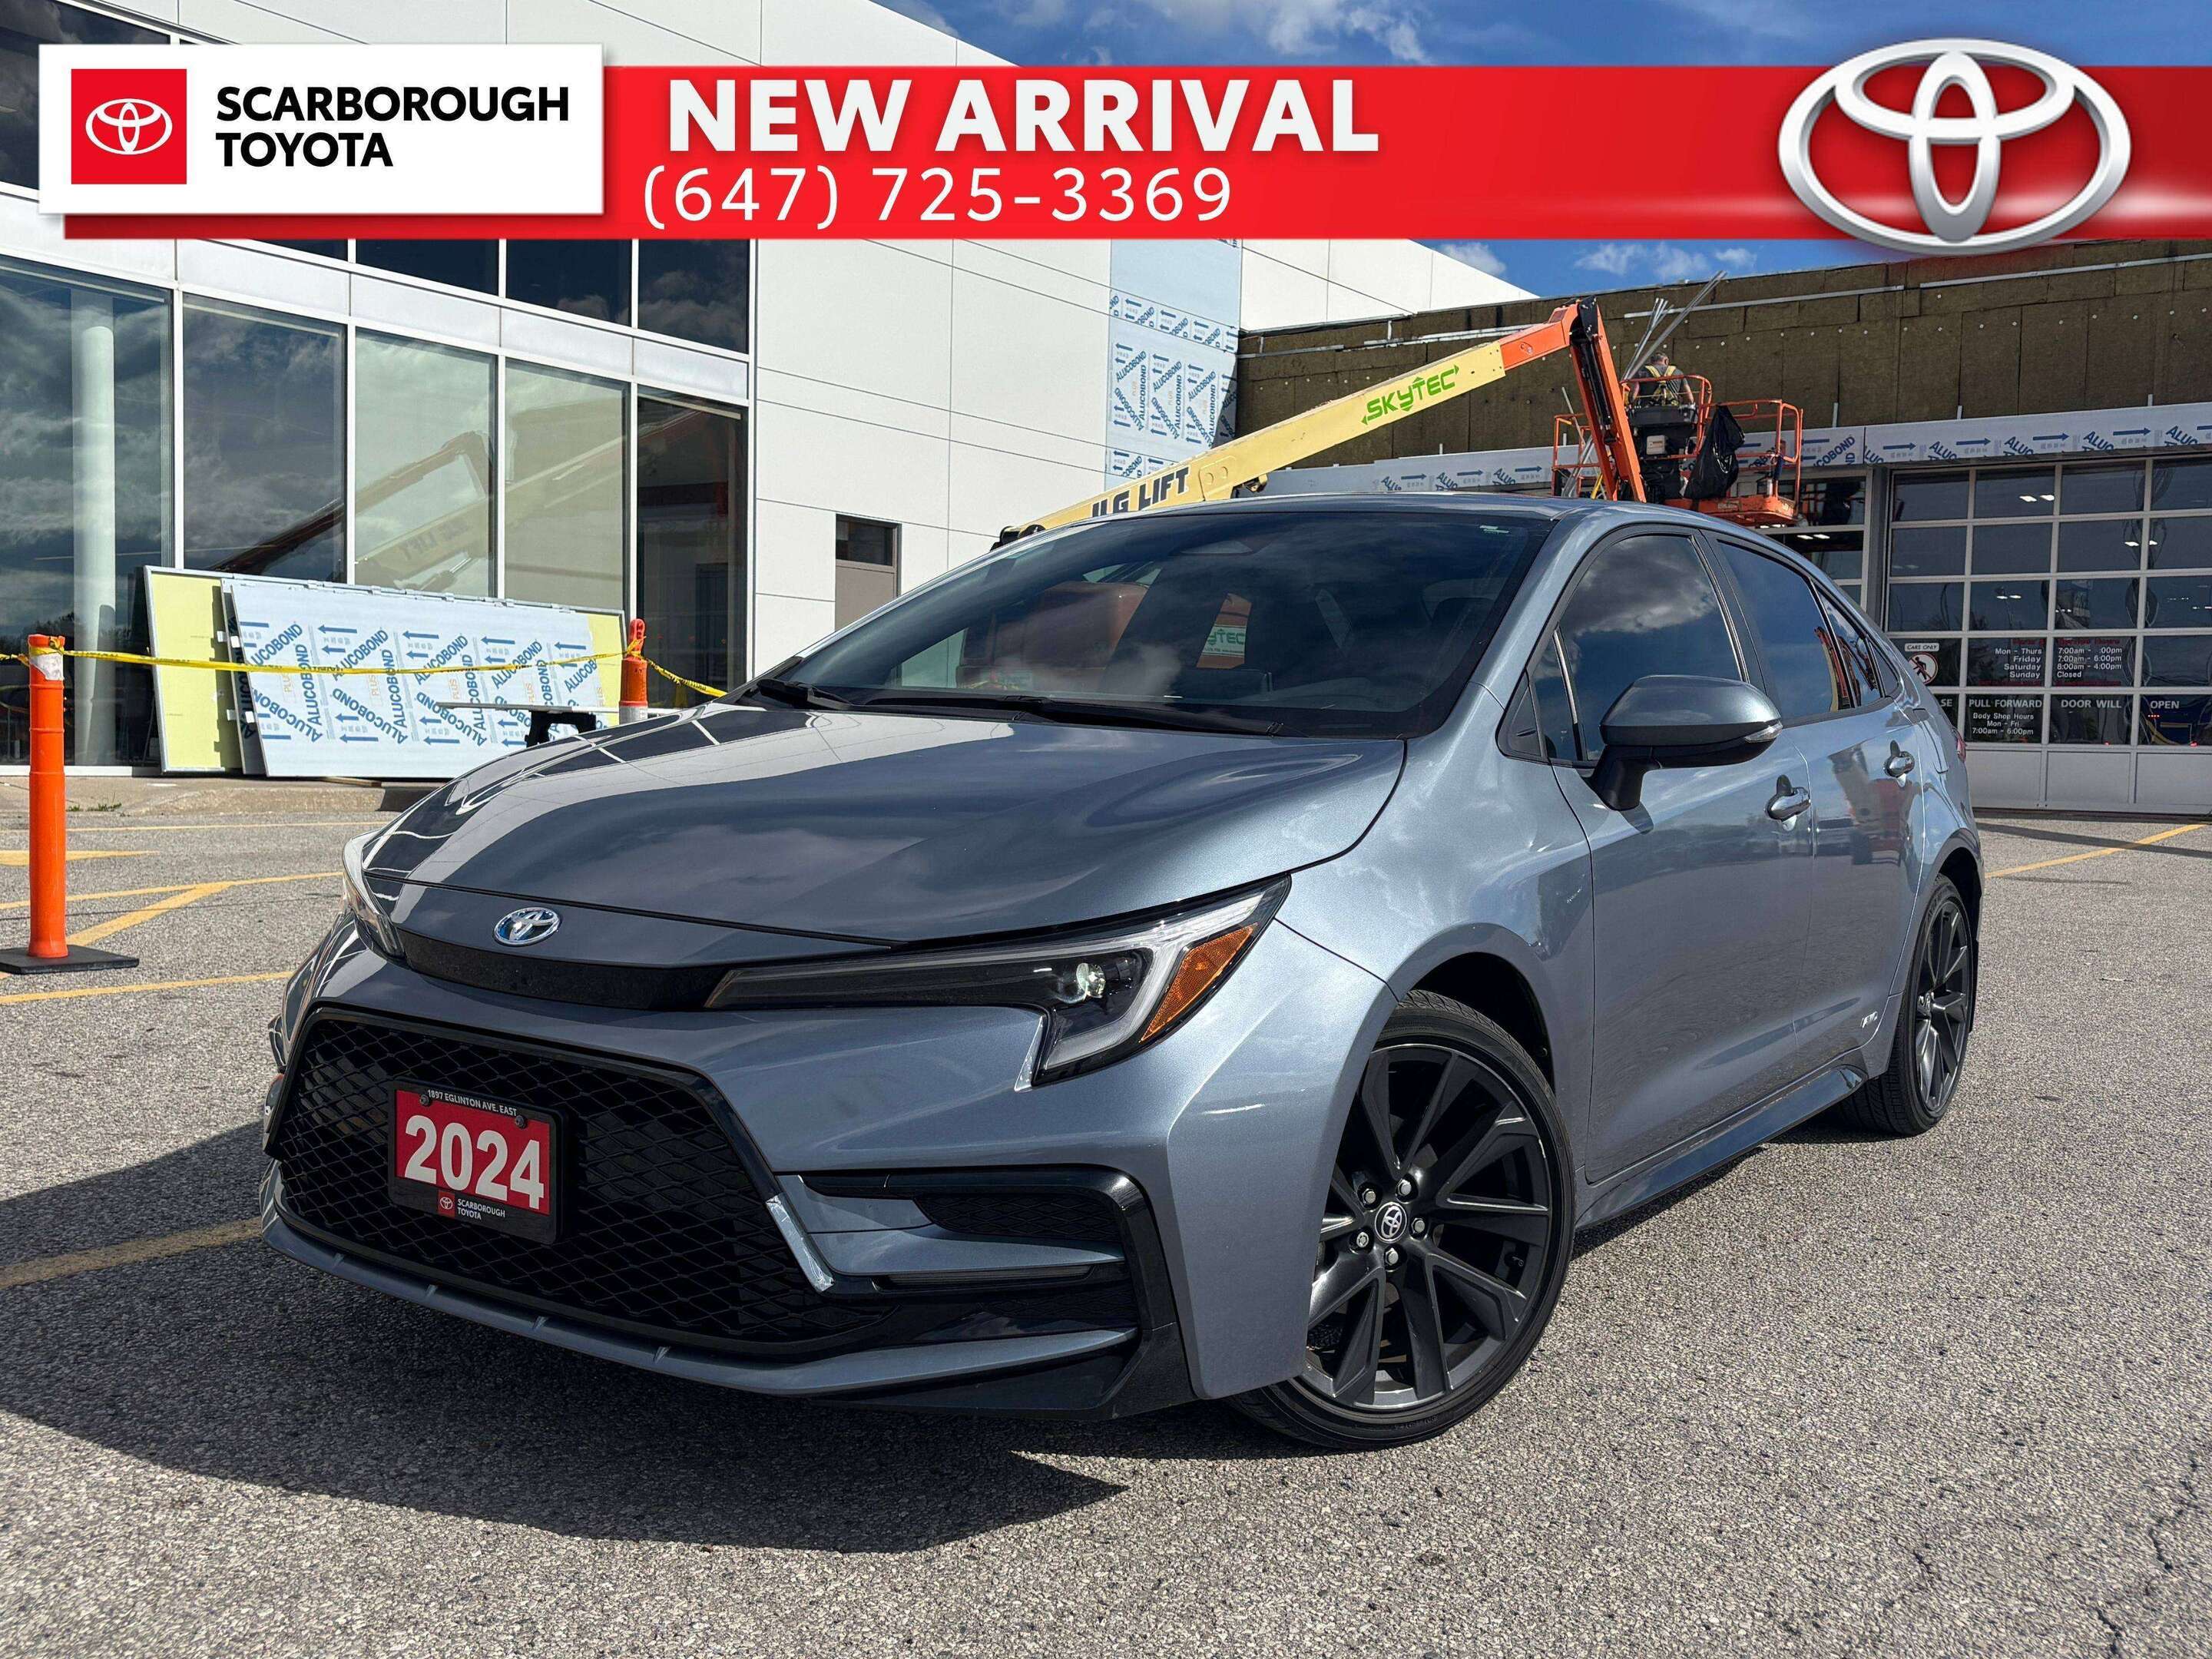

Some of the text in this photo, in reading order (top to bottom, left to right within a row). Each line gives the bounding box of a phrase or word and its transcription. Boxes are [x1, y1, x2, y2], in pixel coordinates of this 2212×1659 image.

[1365, 367, 1457, 423] SKYTEC
[1138, 467, 1189, 511] LIFT
[381, 649, 408, 728] ALUCOBOND
[2009, 671, 2041, 680] Sunday
[332, 688, 408, 743] ALUCOBOND
[1969, 699, 2043, 708] PULL FORWARD
[1973, 712, 1991, 720] Body
[2061, 700, 2180, 709] DOOR WILL OPEN
[416, 691, 487, 747] ALUCOBOND
[427, 1089, 517, 1118] 1897 EGLINTON AVE. EAST
[405, 1114, 545, 1210] 2024
[457, 1198, 505, 1218] SCARBOROUGH
[457, 1207, 482, 1220] TOYOTA
